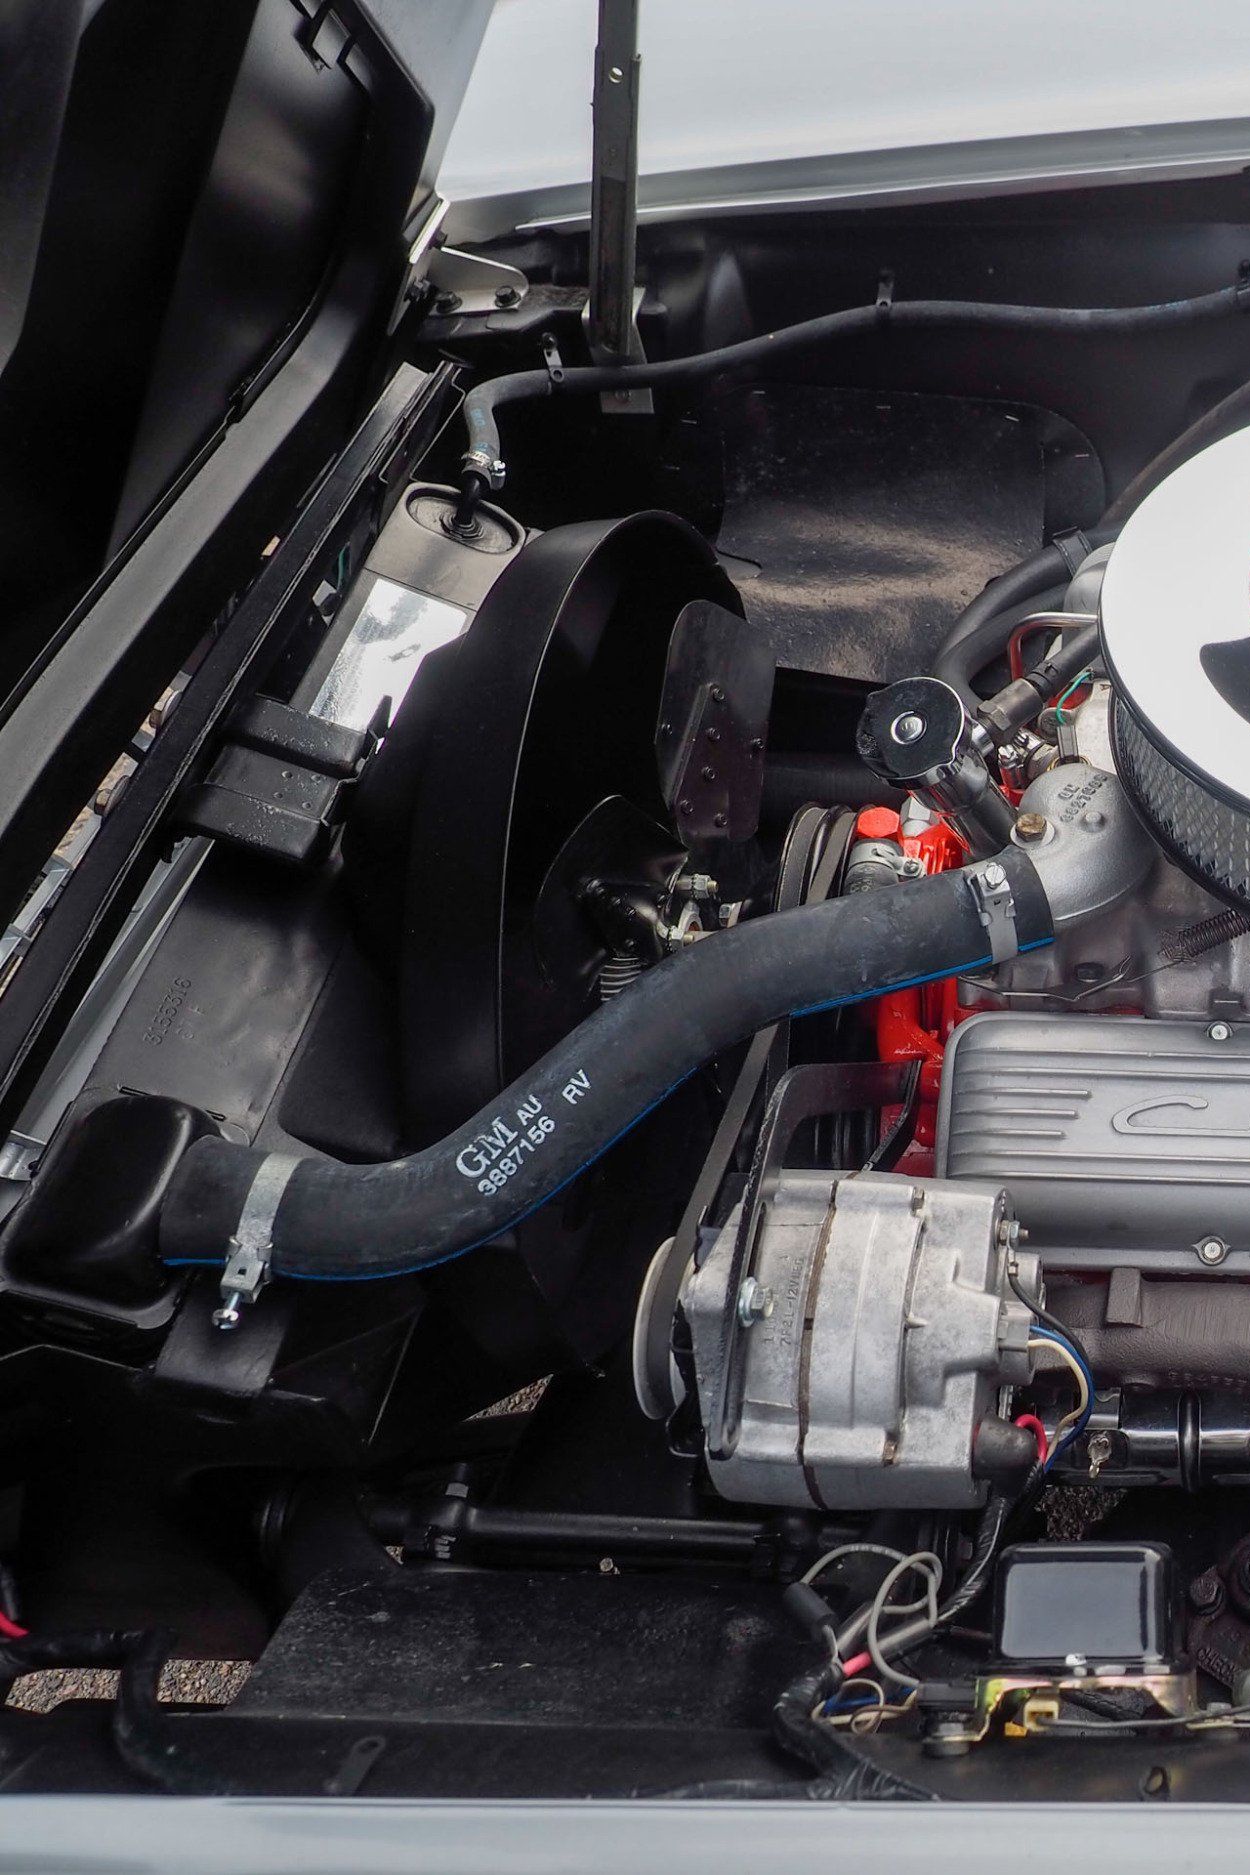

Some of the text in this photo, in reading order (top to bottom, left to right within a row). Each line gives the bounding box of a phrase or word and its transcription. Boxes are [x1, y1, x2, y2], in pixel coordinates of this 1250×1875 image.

[455, 1068, 592, 1178] GM AU RV
[477, 1115, 556, 1196] 3887156
